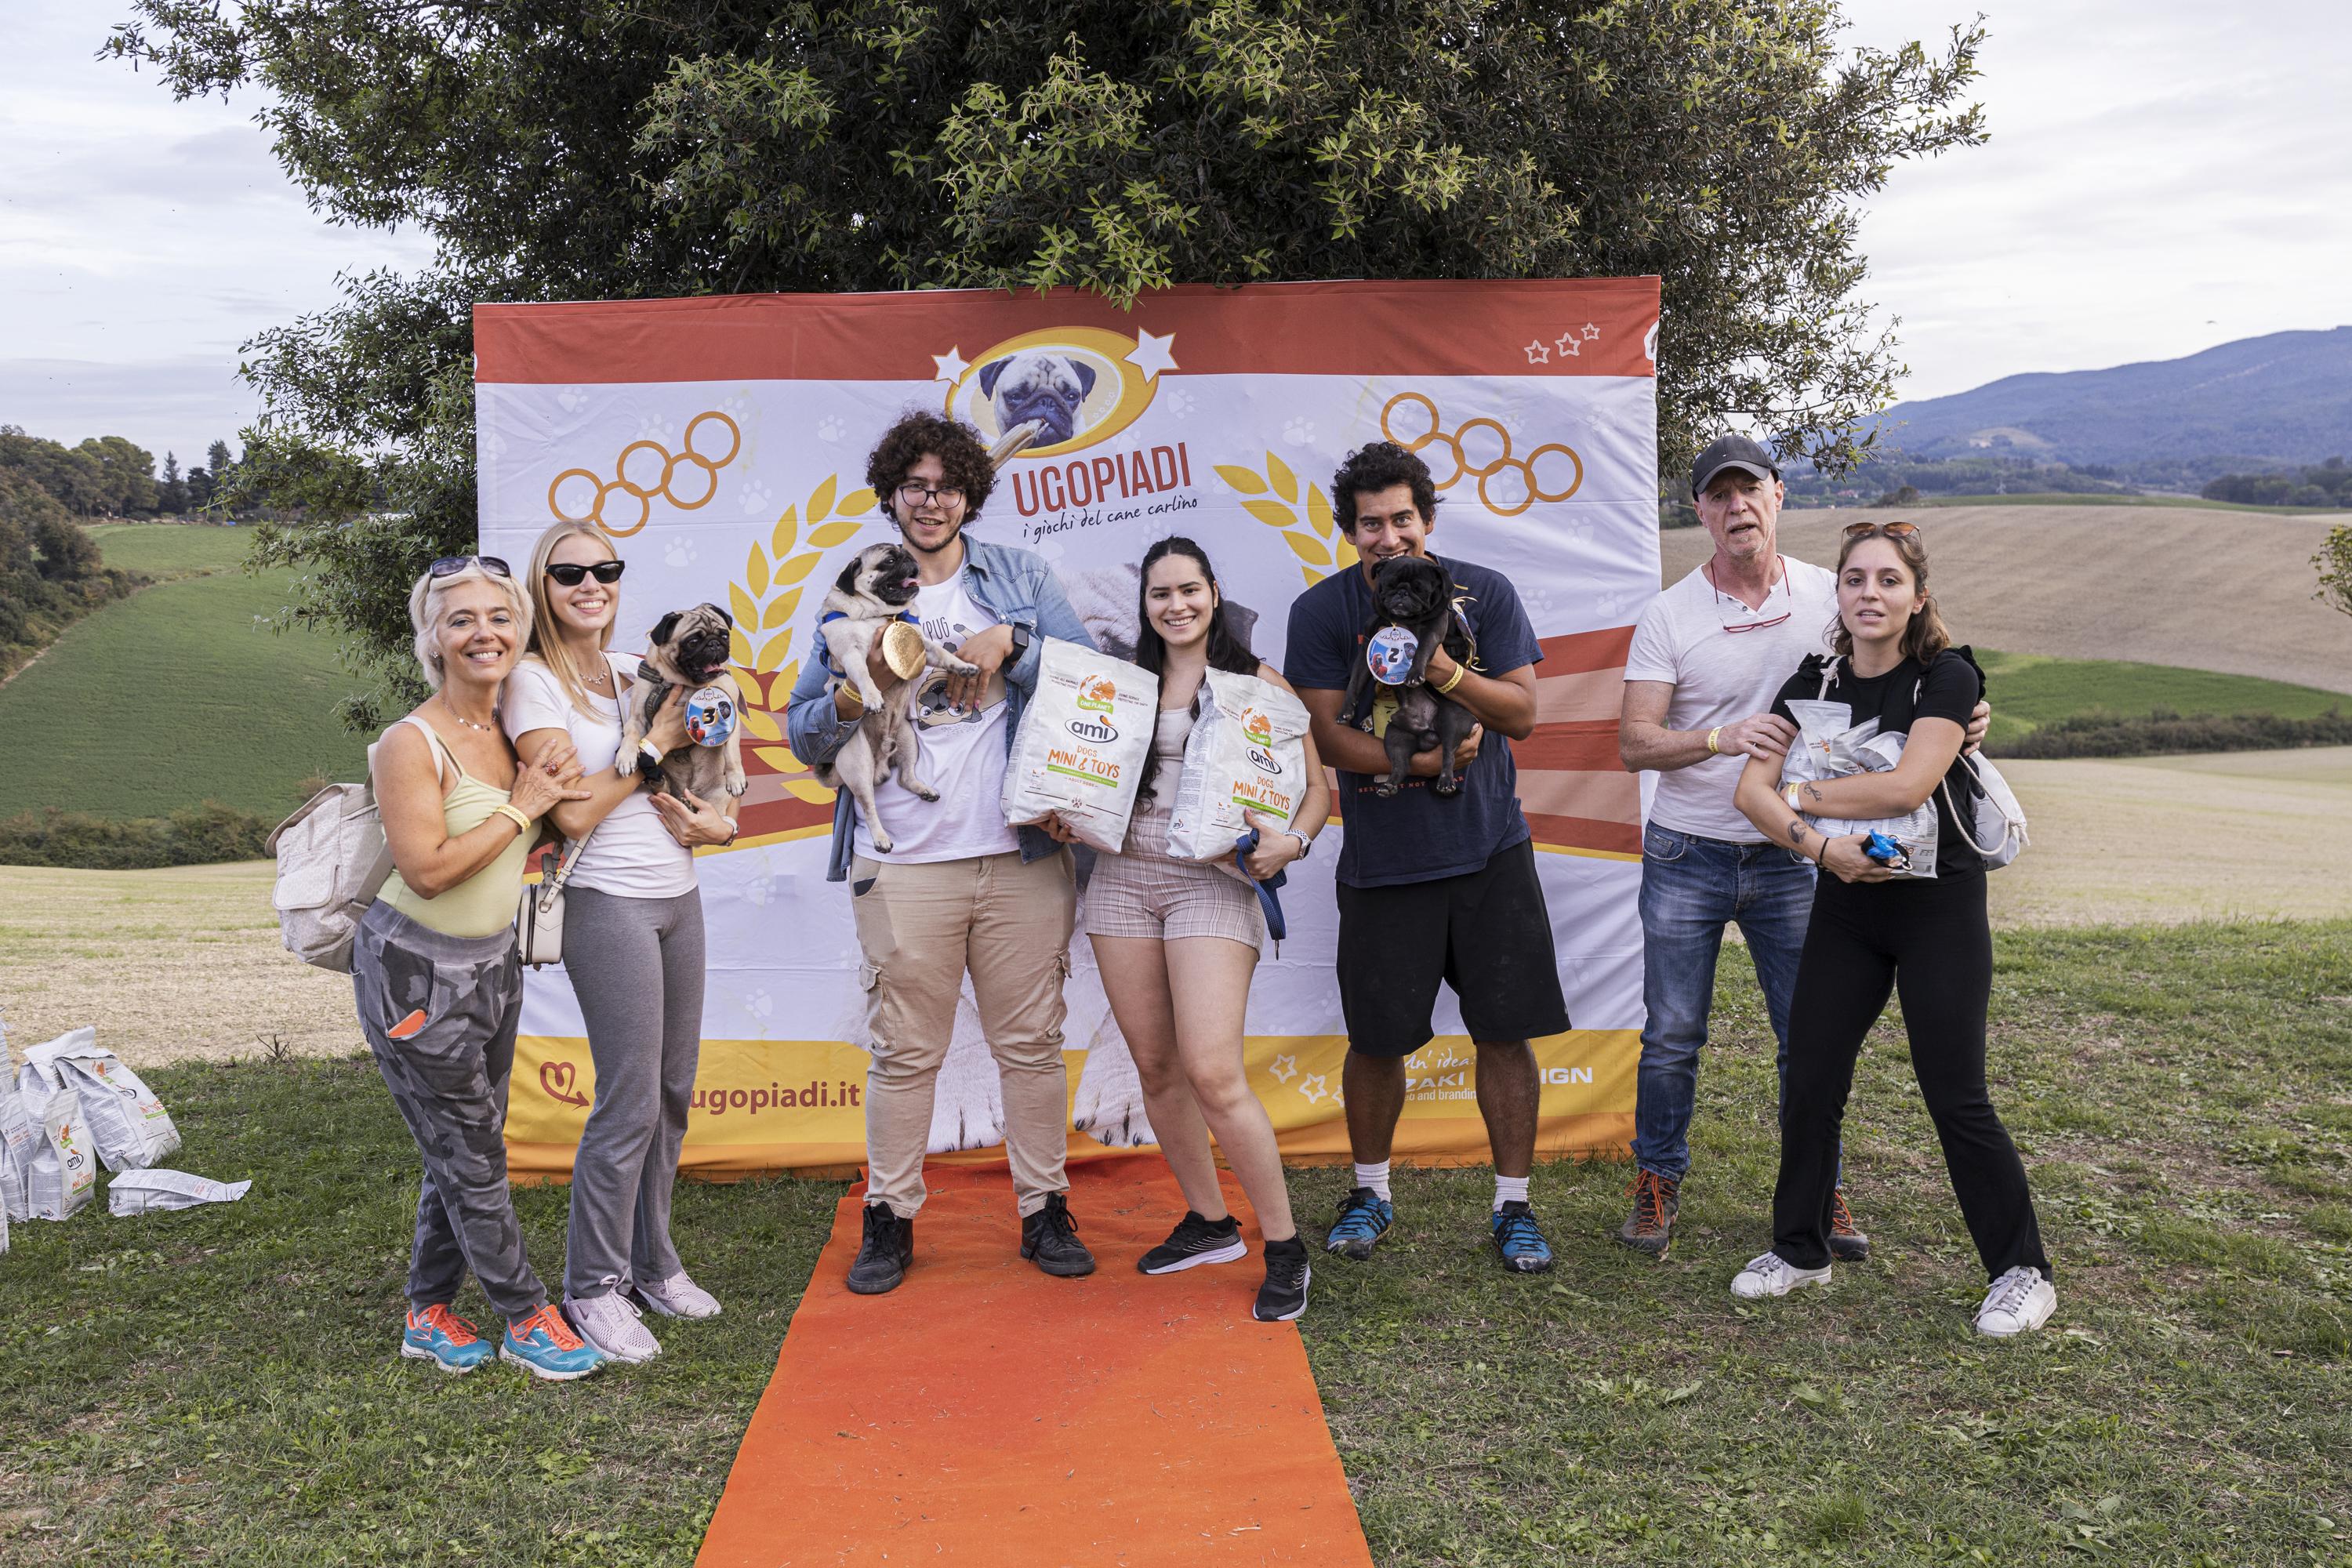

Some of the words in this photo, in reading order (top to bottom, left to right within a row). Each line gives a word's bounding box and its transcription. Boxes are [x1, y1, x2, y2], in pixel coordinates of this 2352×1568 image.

[1011, 441, 1191, 517] UGOPIADI
[1033, 512, 1075, 544] giochi
[1080, 509, 1102, 528] del
[1107, 508, 1142, 522] cane
[1148, 495, 1197, 515] carlino
[923, 616, 949, 641] PUG
[1047, 749, 1077, 767] MINI
[1078, 757, 1087, 771] &
[1091, 759, 1120, 779] TOYS
[1076, 745, 1098, 757] DOGS
[1232, 780, 1258, 798] MINI
[1259, 789, 1266, 803] &
[1269, 790, 1290, 810] TOYS
[1257, 775, 1274, 789] DOGS
[1541, 1067, 1593, 1084] IGN
[690, 1081, 860, 1116] ugopiadi.it
[1405, 1093, 1415, 1102] eb
[1417, 1089, 1436, 1101] and
[1438, 1087, 1476, 1101] brandin
